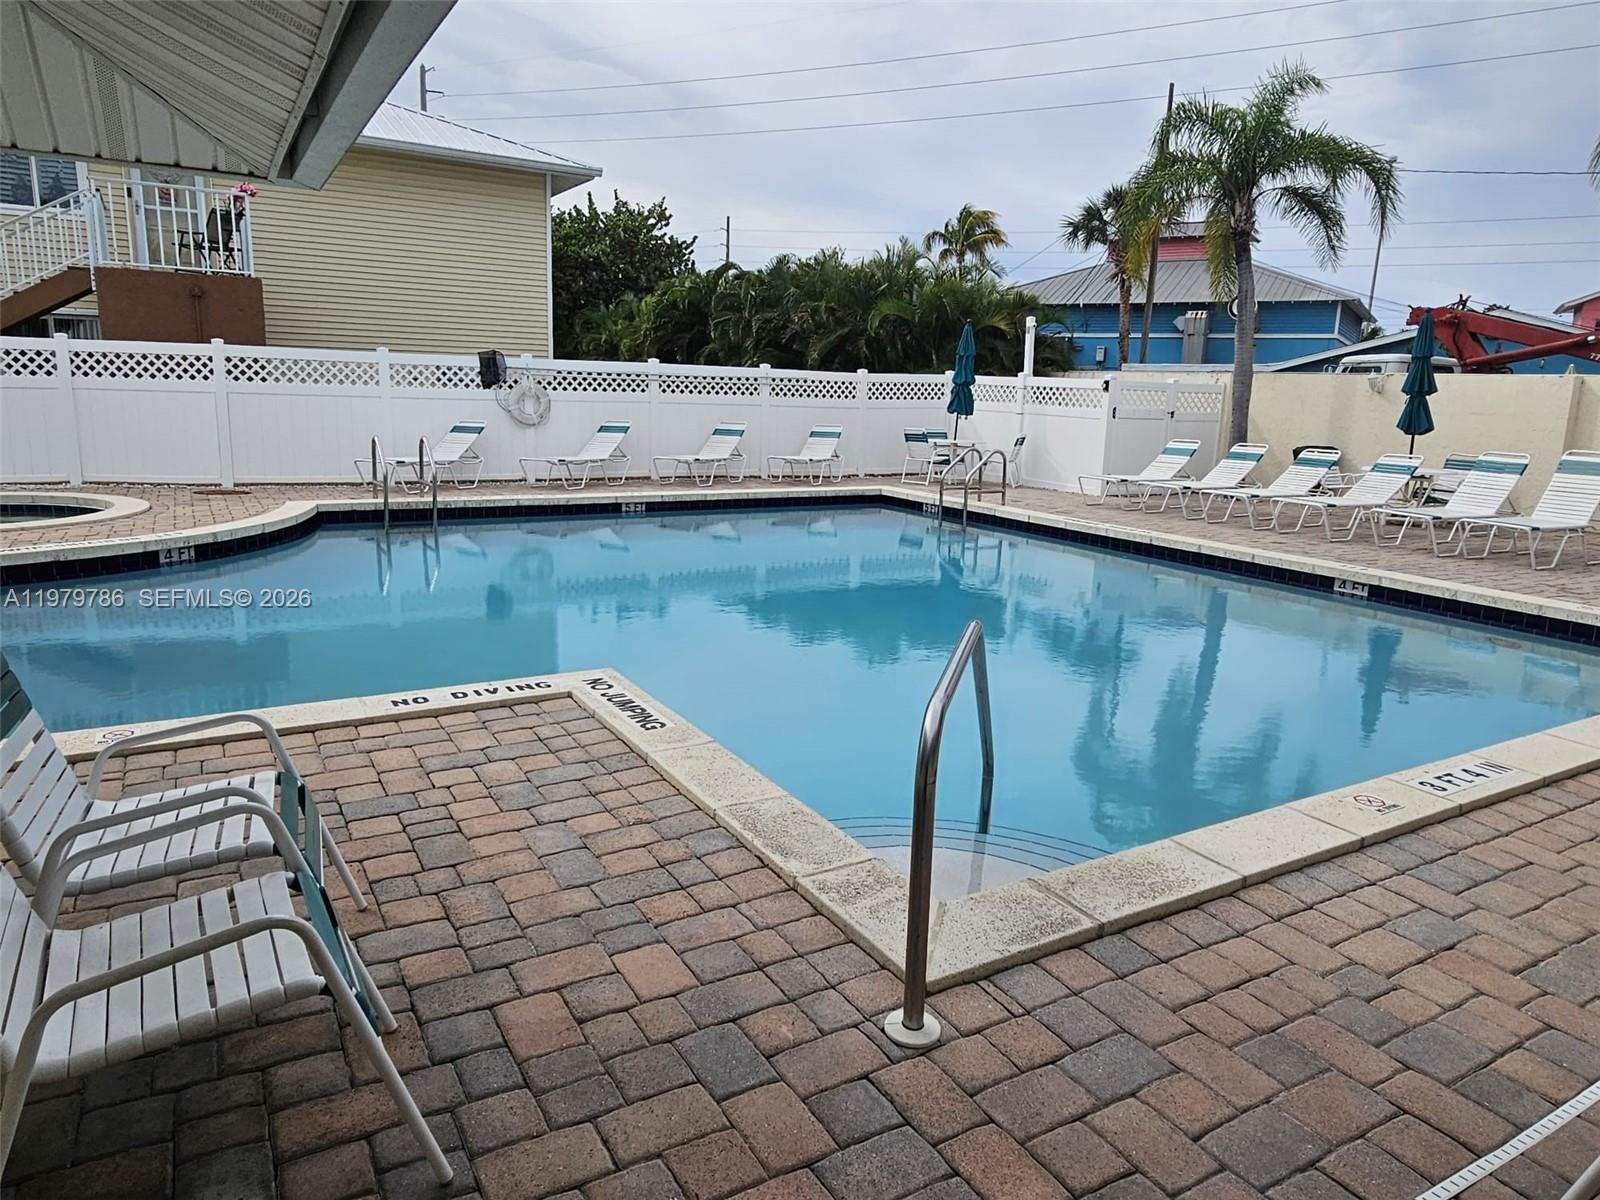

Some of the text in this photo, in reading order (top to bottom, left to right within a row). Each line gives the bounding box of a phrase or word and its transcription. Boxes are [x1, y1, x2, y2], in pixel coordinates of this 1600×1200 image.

[164, 549, 174, 560] 4
[1338, 580, 1347, 589] 4
[391, 681, 553, 707] NO DIVING
[582, 677, 667, 731] NO JUMPING
[1474, 760, 1514, 775] IN
[1460, 768, 1491, 779] 4
[1418, 781, 1449, 792] 3
